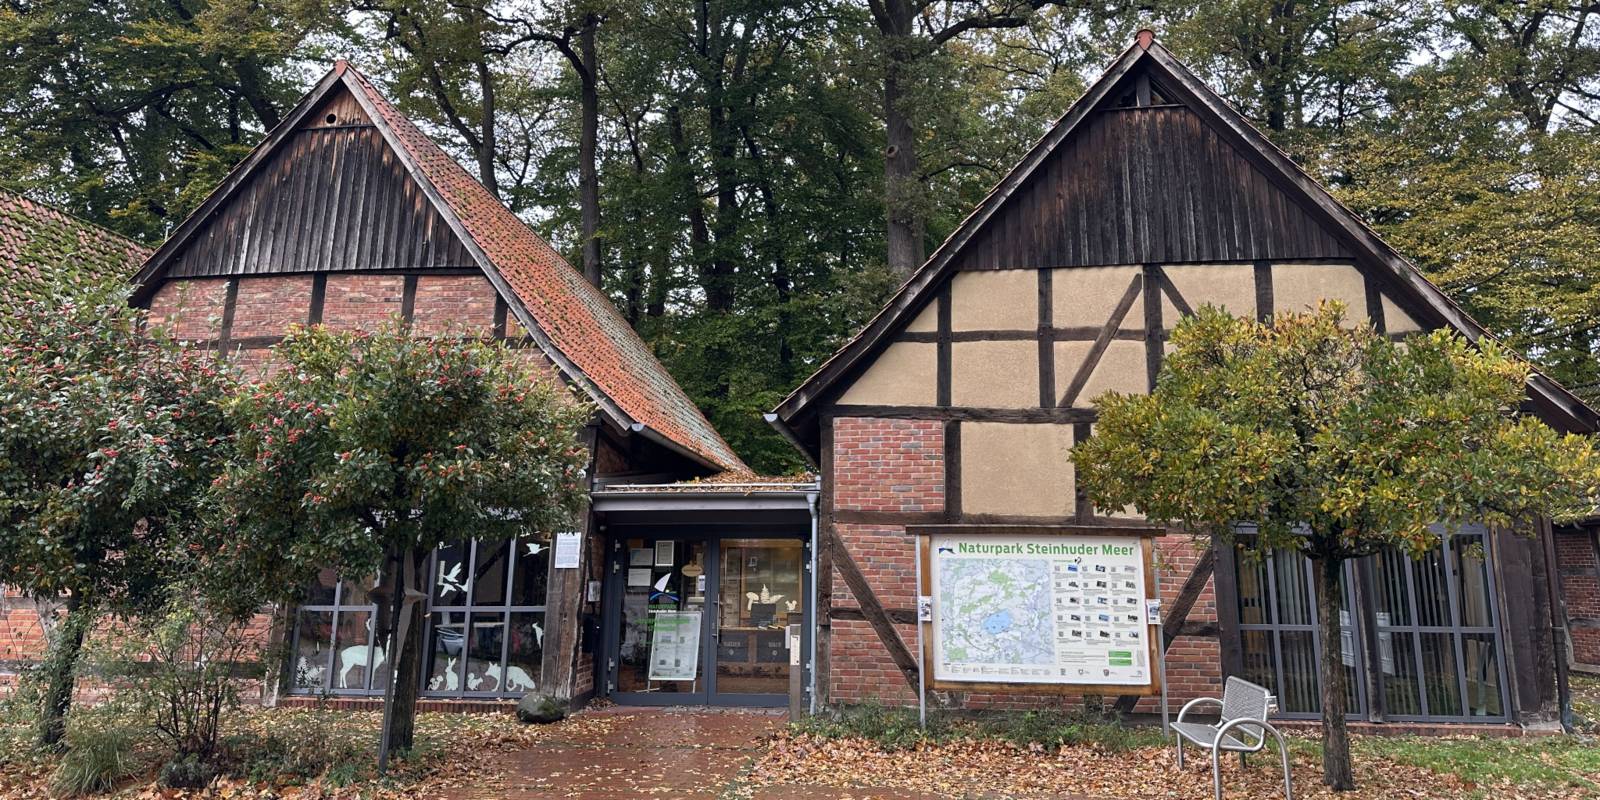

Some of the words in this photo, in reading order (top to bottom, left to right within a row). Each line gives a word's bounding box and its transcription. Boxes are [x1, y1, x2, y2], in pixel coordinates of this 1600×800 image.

[959, 542, 1024, 555] Naturpark
[1027, 543, 1098, 555] Steinhuder
[1102, 544, 1134, 556] Meer
